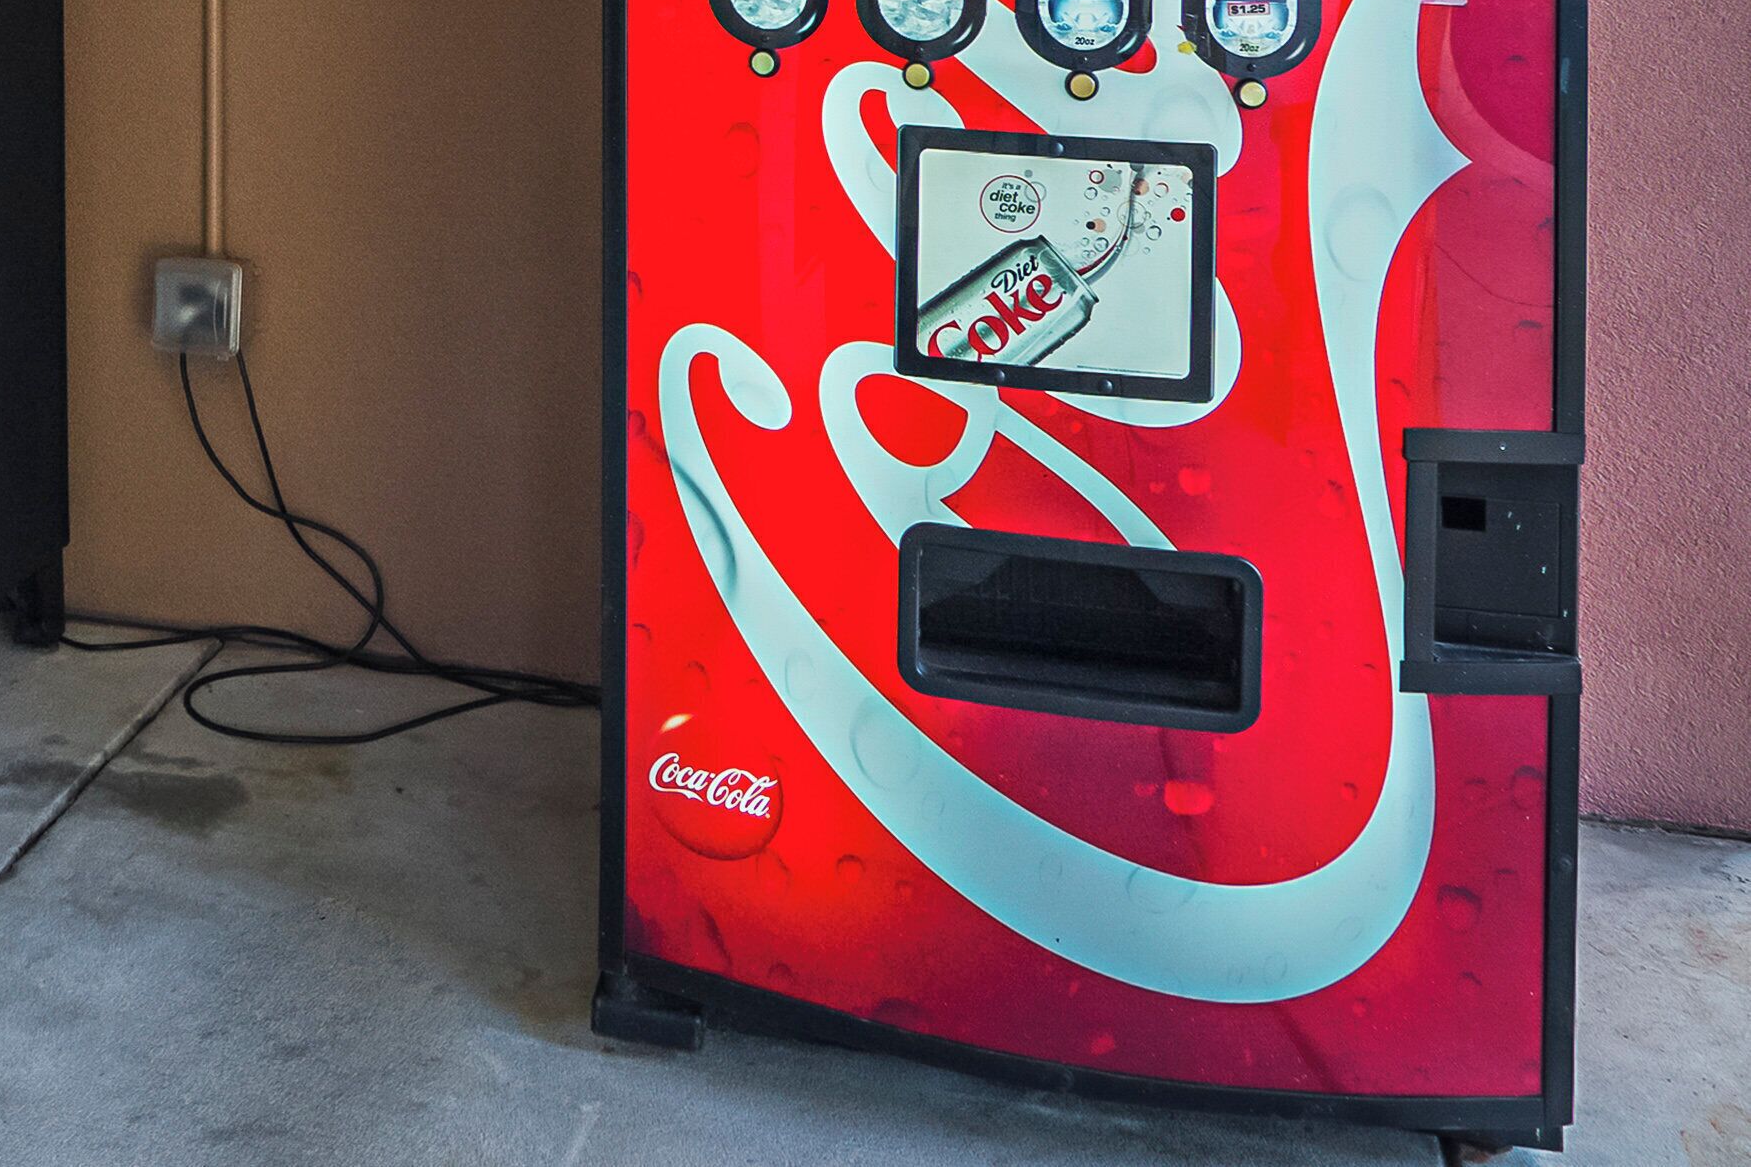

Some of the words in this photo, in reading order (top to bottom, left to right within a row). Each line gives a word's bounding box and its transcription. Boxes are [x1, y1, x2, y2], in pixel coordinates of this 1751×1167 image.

[1230, 4, 1266, 15] $1.25
[1074, 36, 1095, 46] 20oz
[1002, 182, 1014, 190] it's
[989, 190, 1019, 203] diet
[999, 201, 1036, 215] coke
[994, 213, 1017, 223] thing
[991, 255, 1040, 295] Diet
[927, 273, 1066, 363] Coke
[649, 752, 778, 819] Coca-Cola
